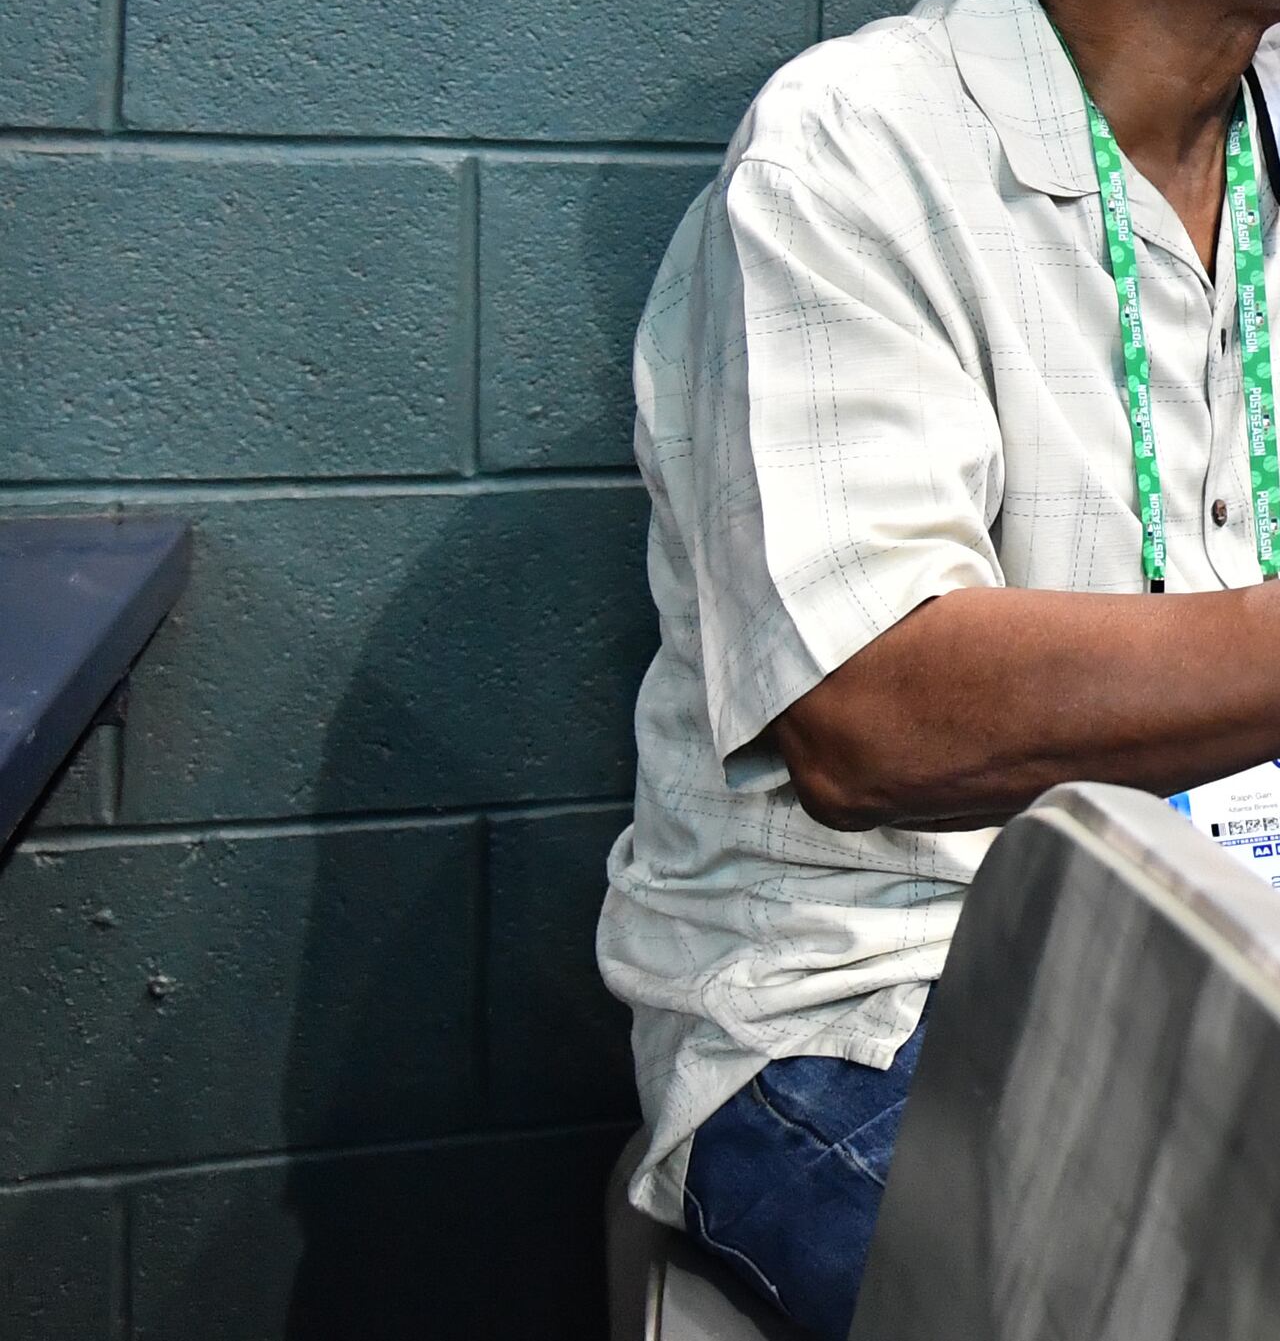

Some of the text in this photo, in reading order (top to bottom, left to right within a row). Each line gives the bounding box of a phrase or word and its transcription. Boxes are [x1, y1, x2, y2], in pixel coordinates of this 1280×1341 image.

[1109, 172, 1129, 241] POSTSEASON
[1233, 185, 1251, 251] POSTSEASON
[1124, 276, 1142, 348] POSTSEASON
[1243, 284, 1259, 353] POSTSEASON
[1138, 384, 1154, 457] POSTSEASON
[1249, 387, 1266, 456] POSTSEASON
[1149, 493, 1164, 567] POSTSEASON
[1256, 490, 1273, 561] POSTSEASON
[1255, 847, 1271, 856] AA
